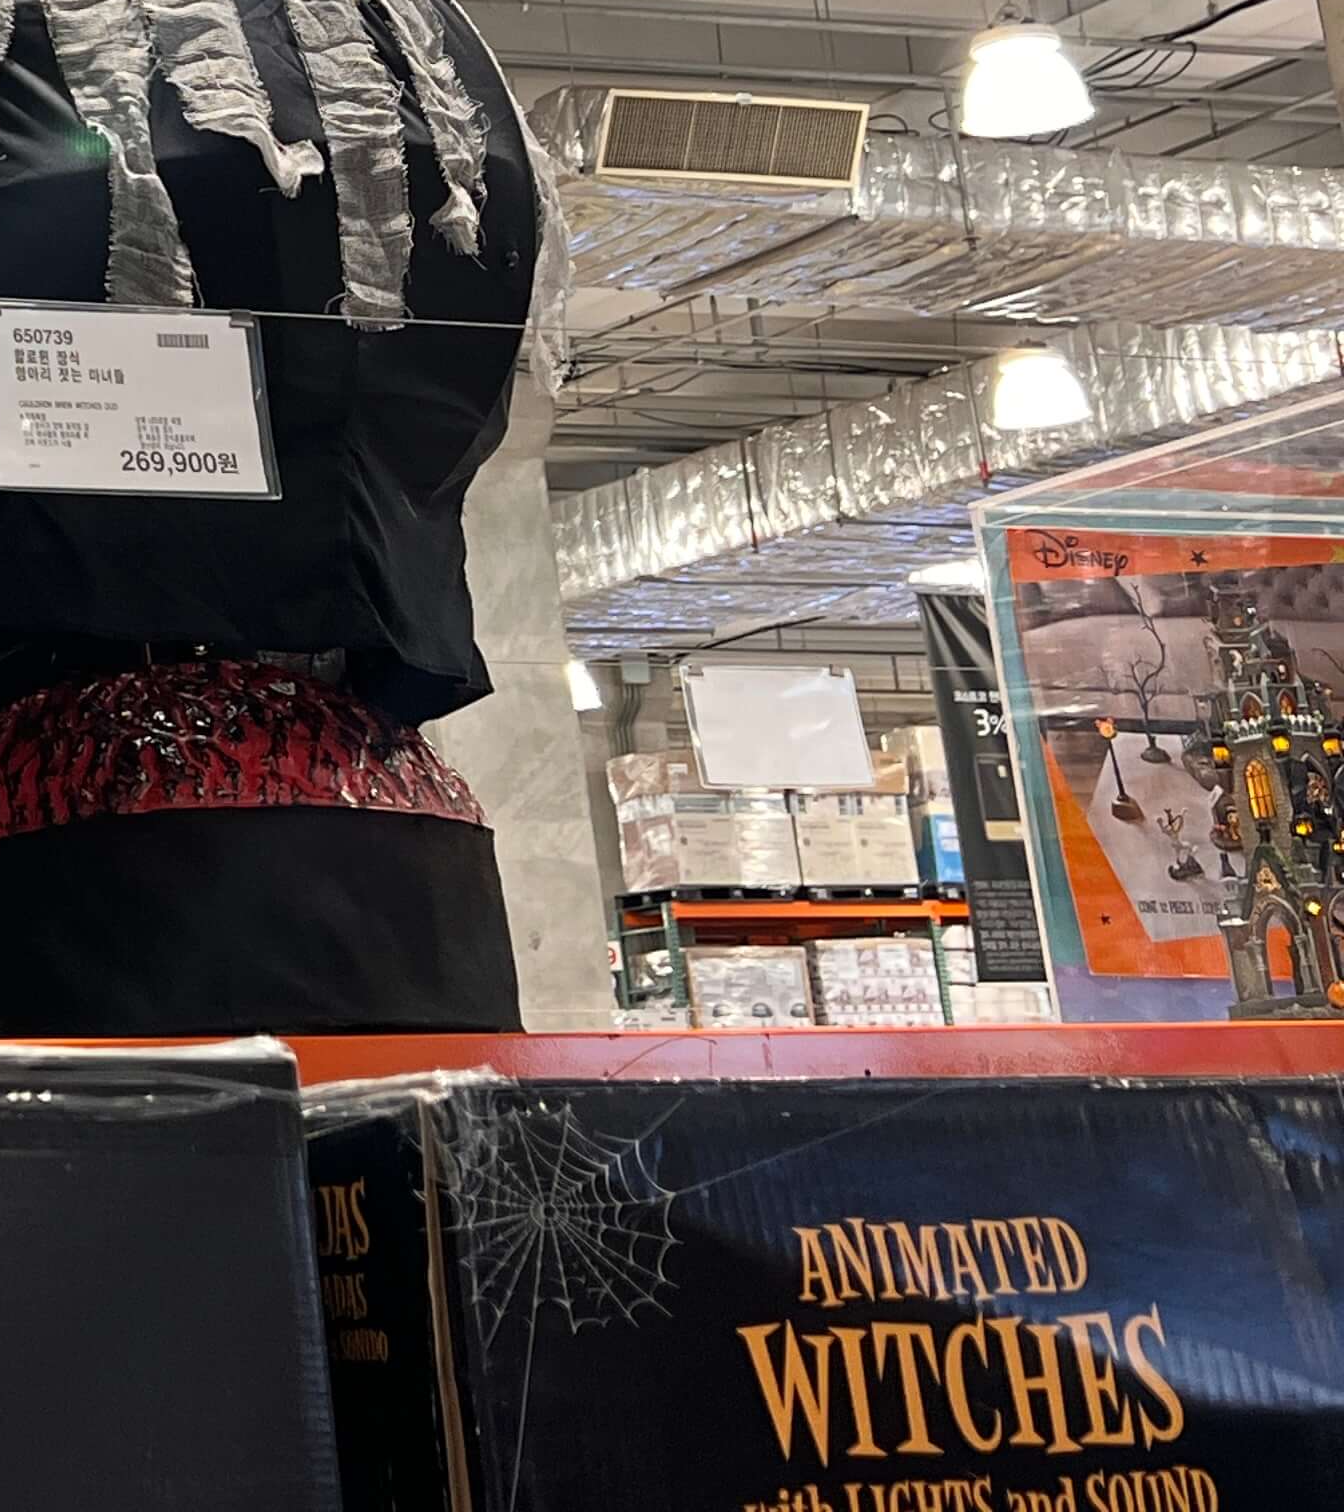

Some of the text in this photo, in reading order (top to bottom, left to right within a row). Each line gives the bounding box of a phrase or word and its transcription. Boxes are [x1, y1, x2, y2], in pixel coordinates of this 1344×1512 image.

[13, 328, 73, 345] 650739
[15, 349, 80, 366] 할로윈 장식
[89, 368, 124, 384] 마녀들
[120, 450, 239, 476] 269,900원
[318, 1176, 370, 1257] JAS
[792, 1217, 1089, 1308] ANIMATED
[736, 1302, 1185, 1470] WITCHES
[1086, 1465, 1219, 1512] SOUND
